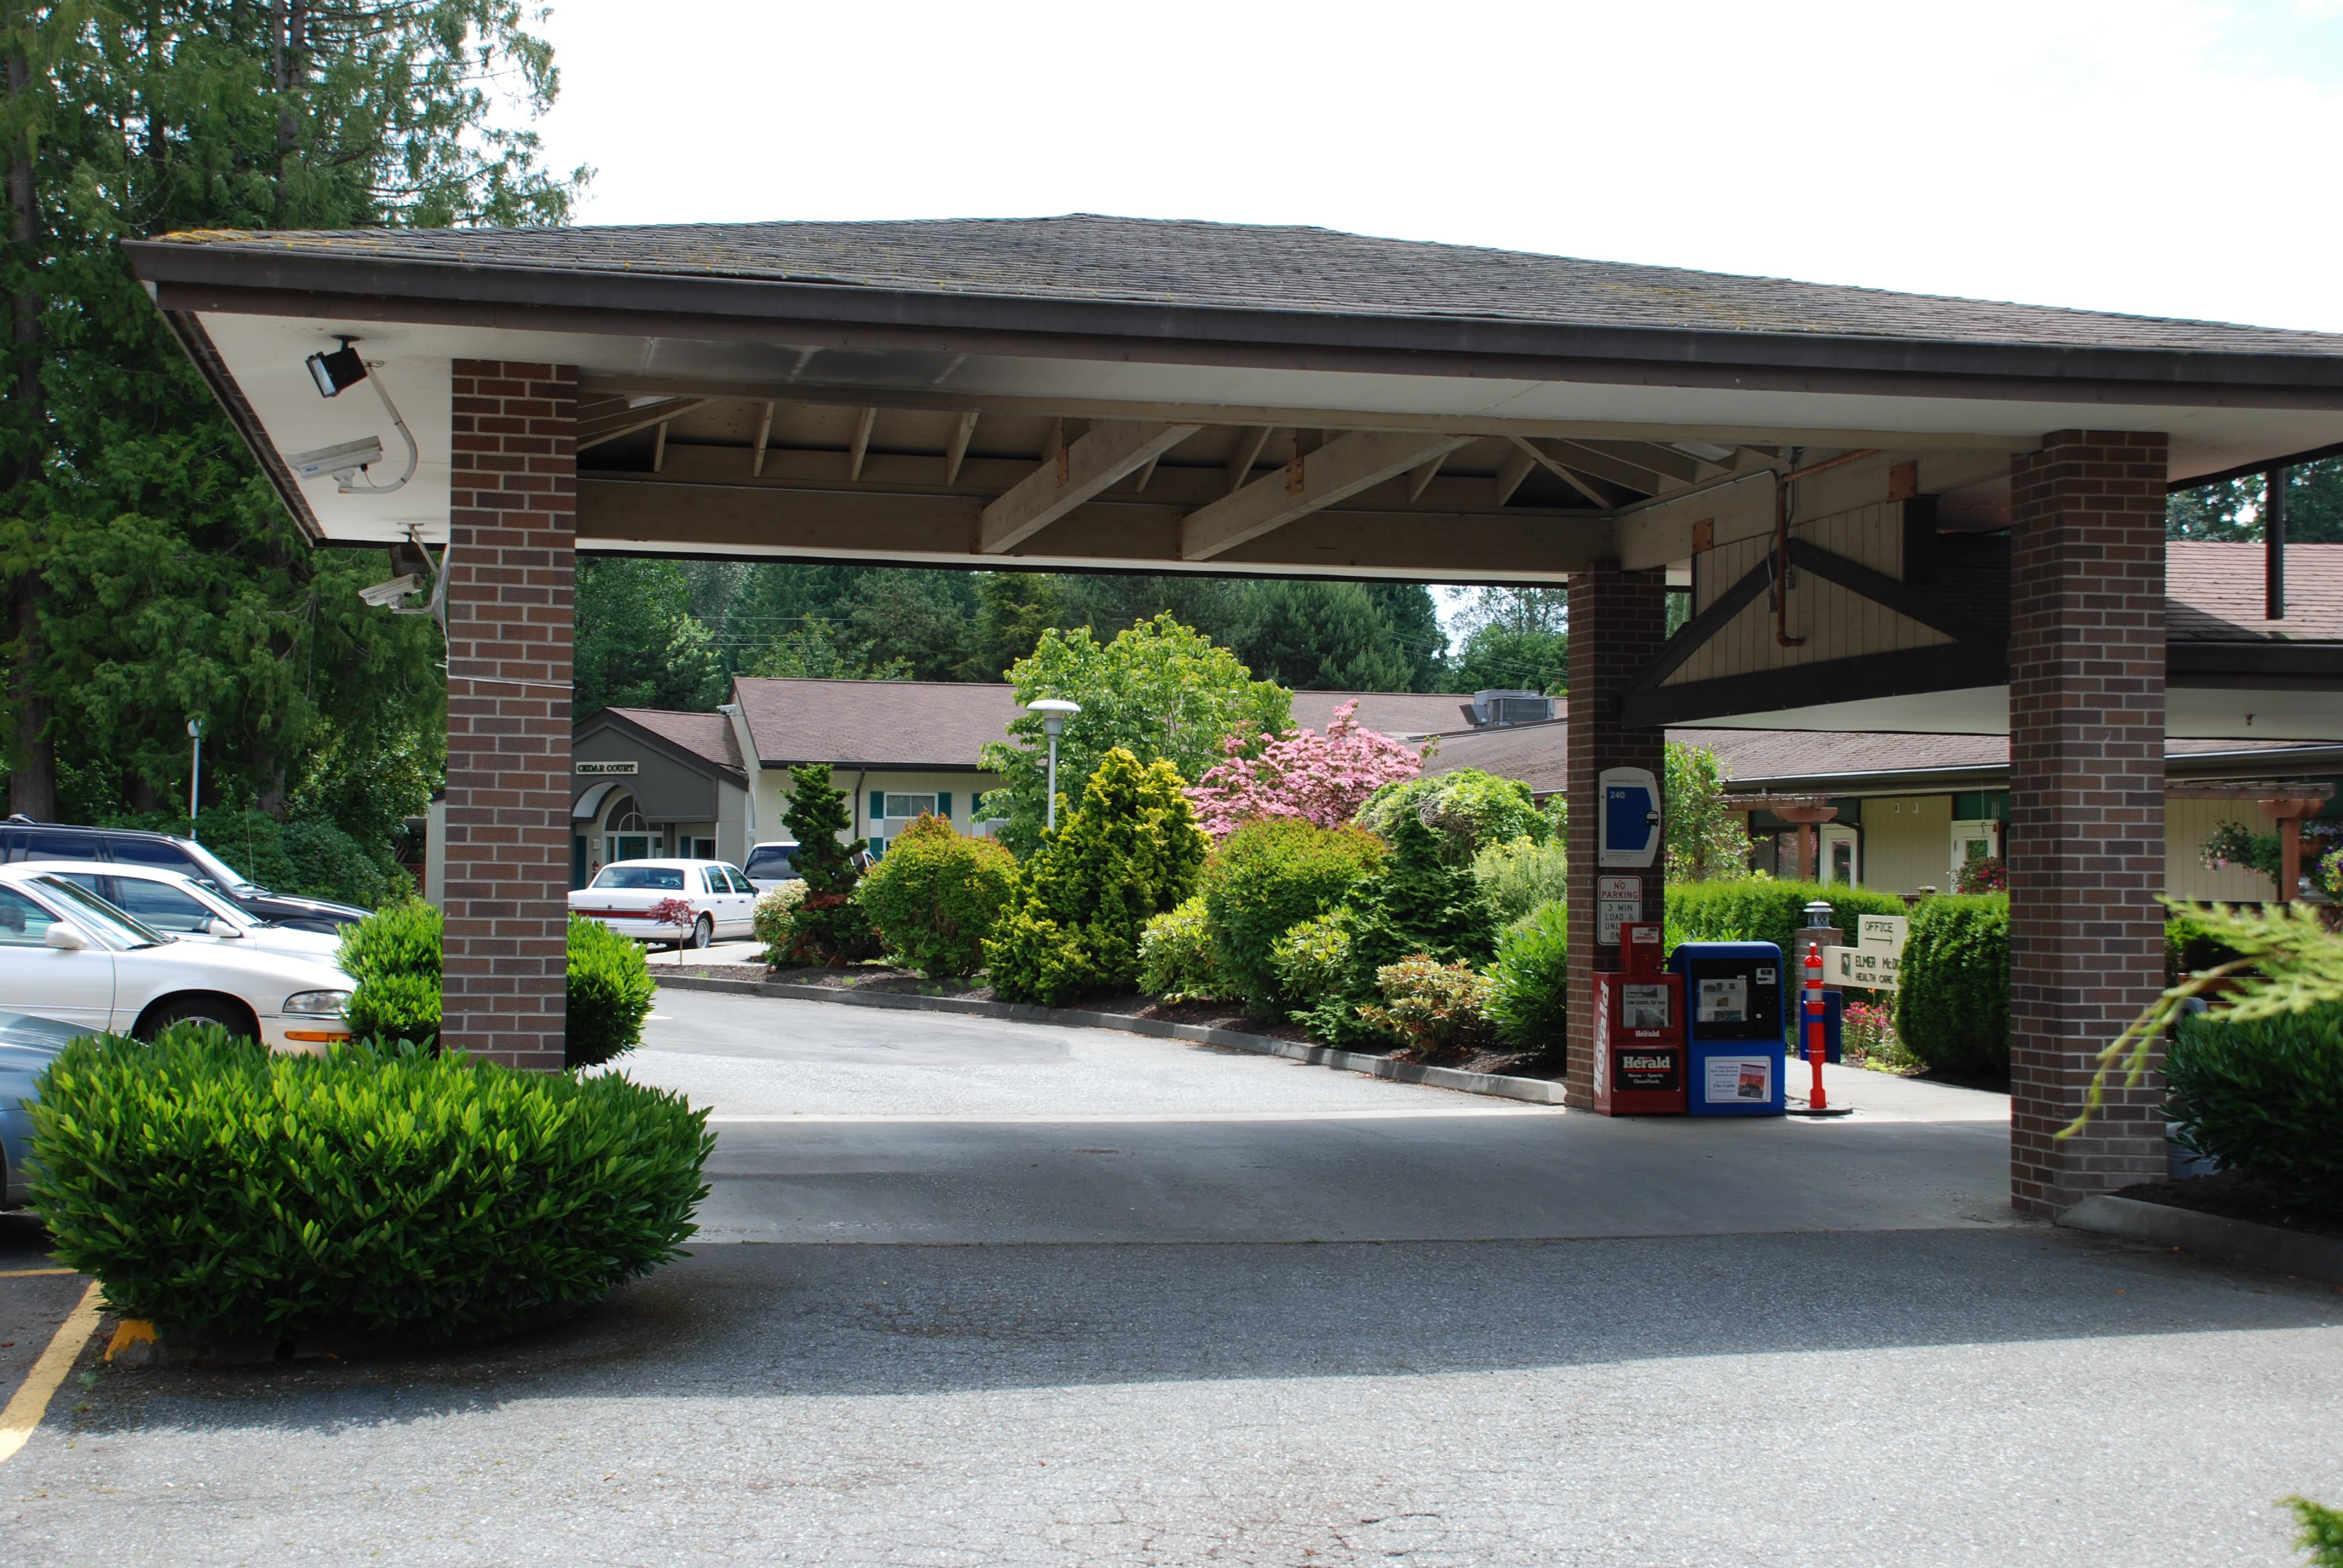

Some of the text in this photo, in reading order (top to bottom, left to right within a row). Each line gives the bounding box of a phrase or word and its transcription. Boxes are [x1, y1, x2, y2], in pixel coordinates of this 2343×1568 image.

[1864, 921, 1893, 933] OFFICE
[1855, 955, 1900, 970] ELMER McD
[1855, 972, 1893, 984] HEALTH CARE
[1594, 981, 1609, 1099] Herald
[1623, 1056, 1671, 1069] Herald
